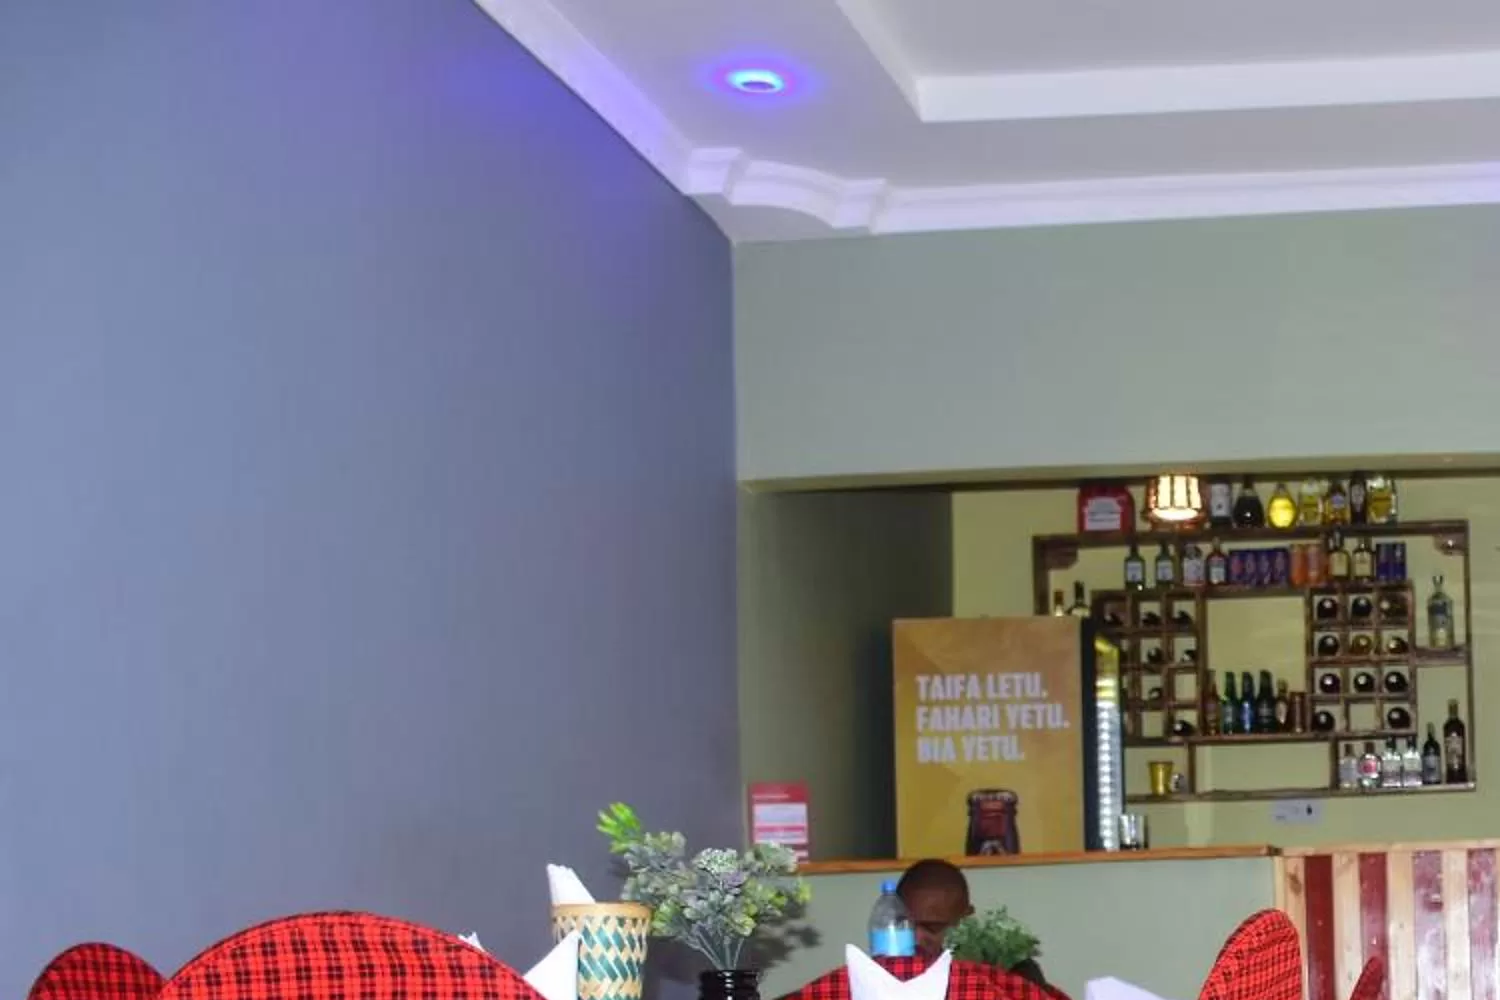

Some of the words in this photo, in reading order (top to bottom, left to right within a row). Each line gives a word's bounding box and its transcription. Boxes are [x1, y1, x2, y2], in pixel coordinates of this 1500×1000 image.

[915, 673, 980, 700] TAIFA
[987, 672, 1048, 698] LETU.
[916, 704, 1000, 732] FAHARI
[1005, 703, 1071, 730] YETU.
[917, 735, 956, 763] BIA
